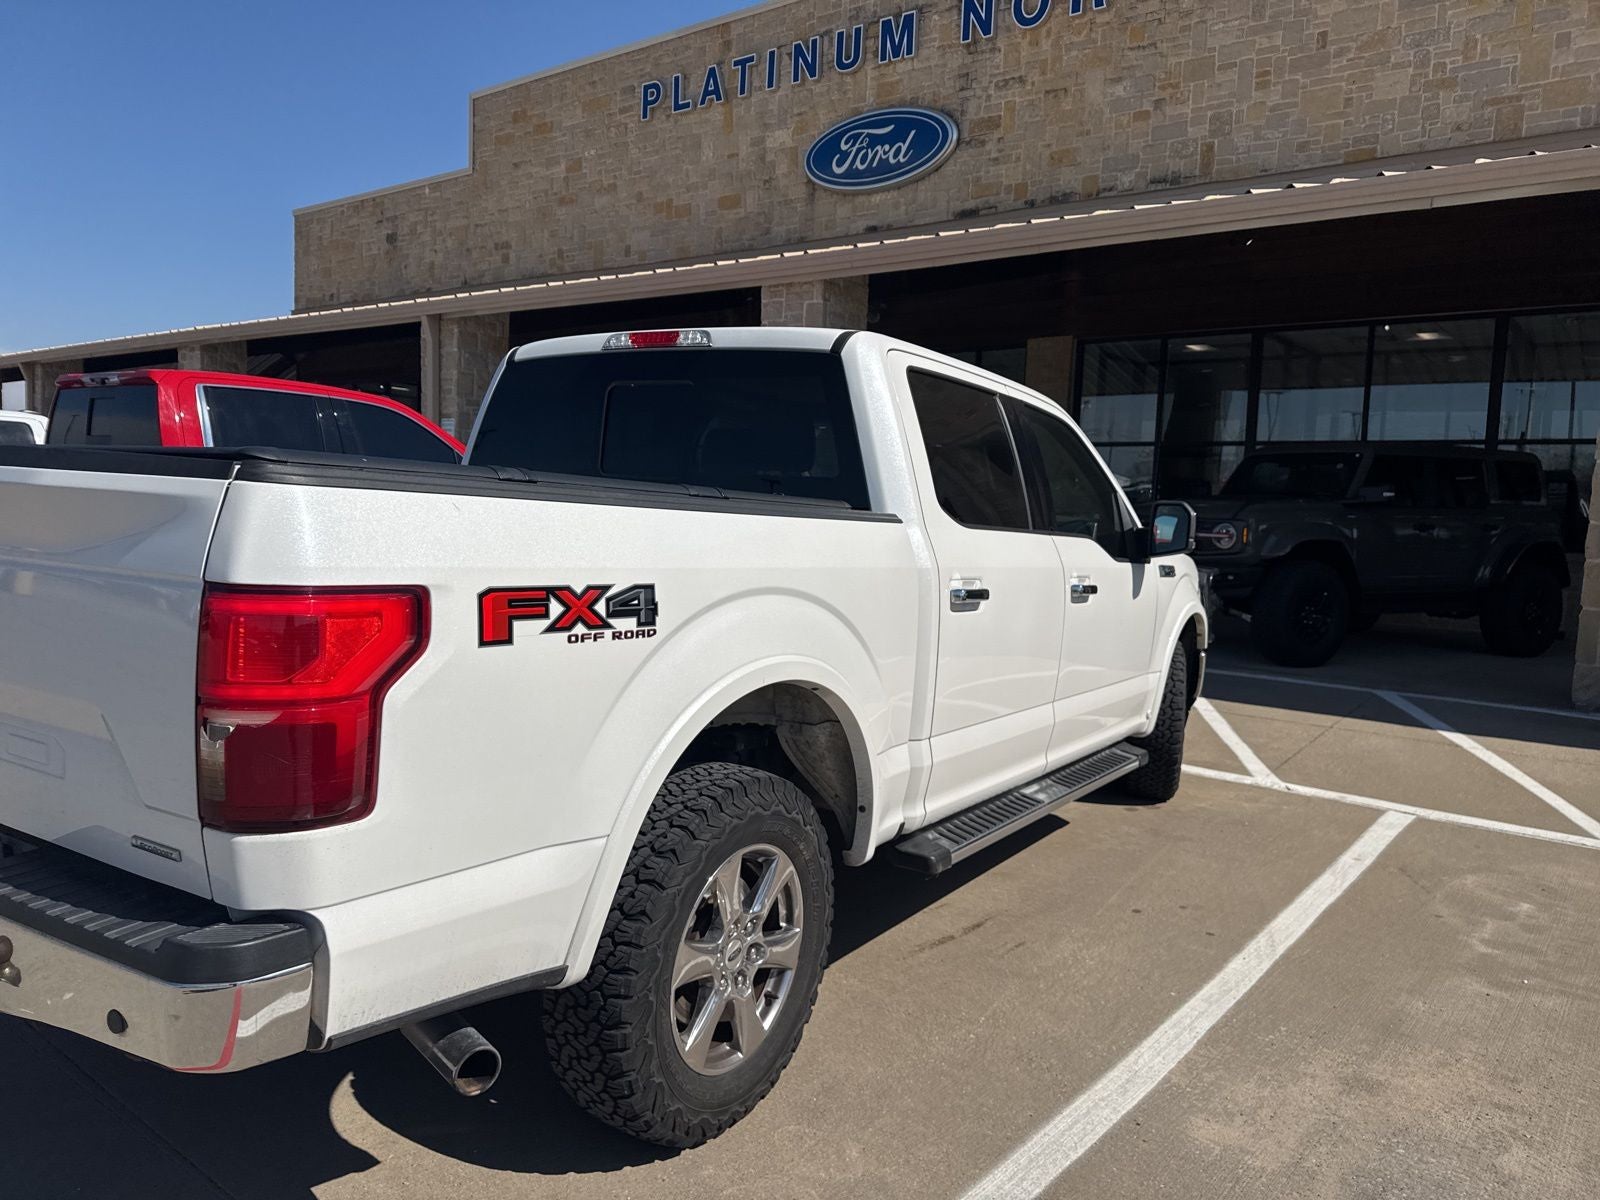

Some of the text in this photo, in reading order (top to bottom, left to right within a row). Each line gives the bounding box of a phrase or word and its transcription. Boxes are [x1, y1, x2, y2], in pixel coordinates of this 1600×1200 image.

[640, 0, 1107, 121] PLATINUM NO
[832, 124, 916, 175] Ford
[477, 583, 659, 648] FX4
[567, 628, 657, 644] OFF ROAD
